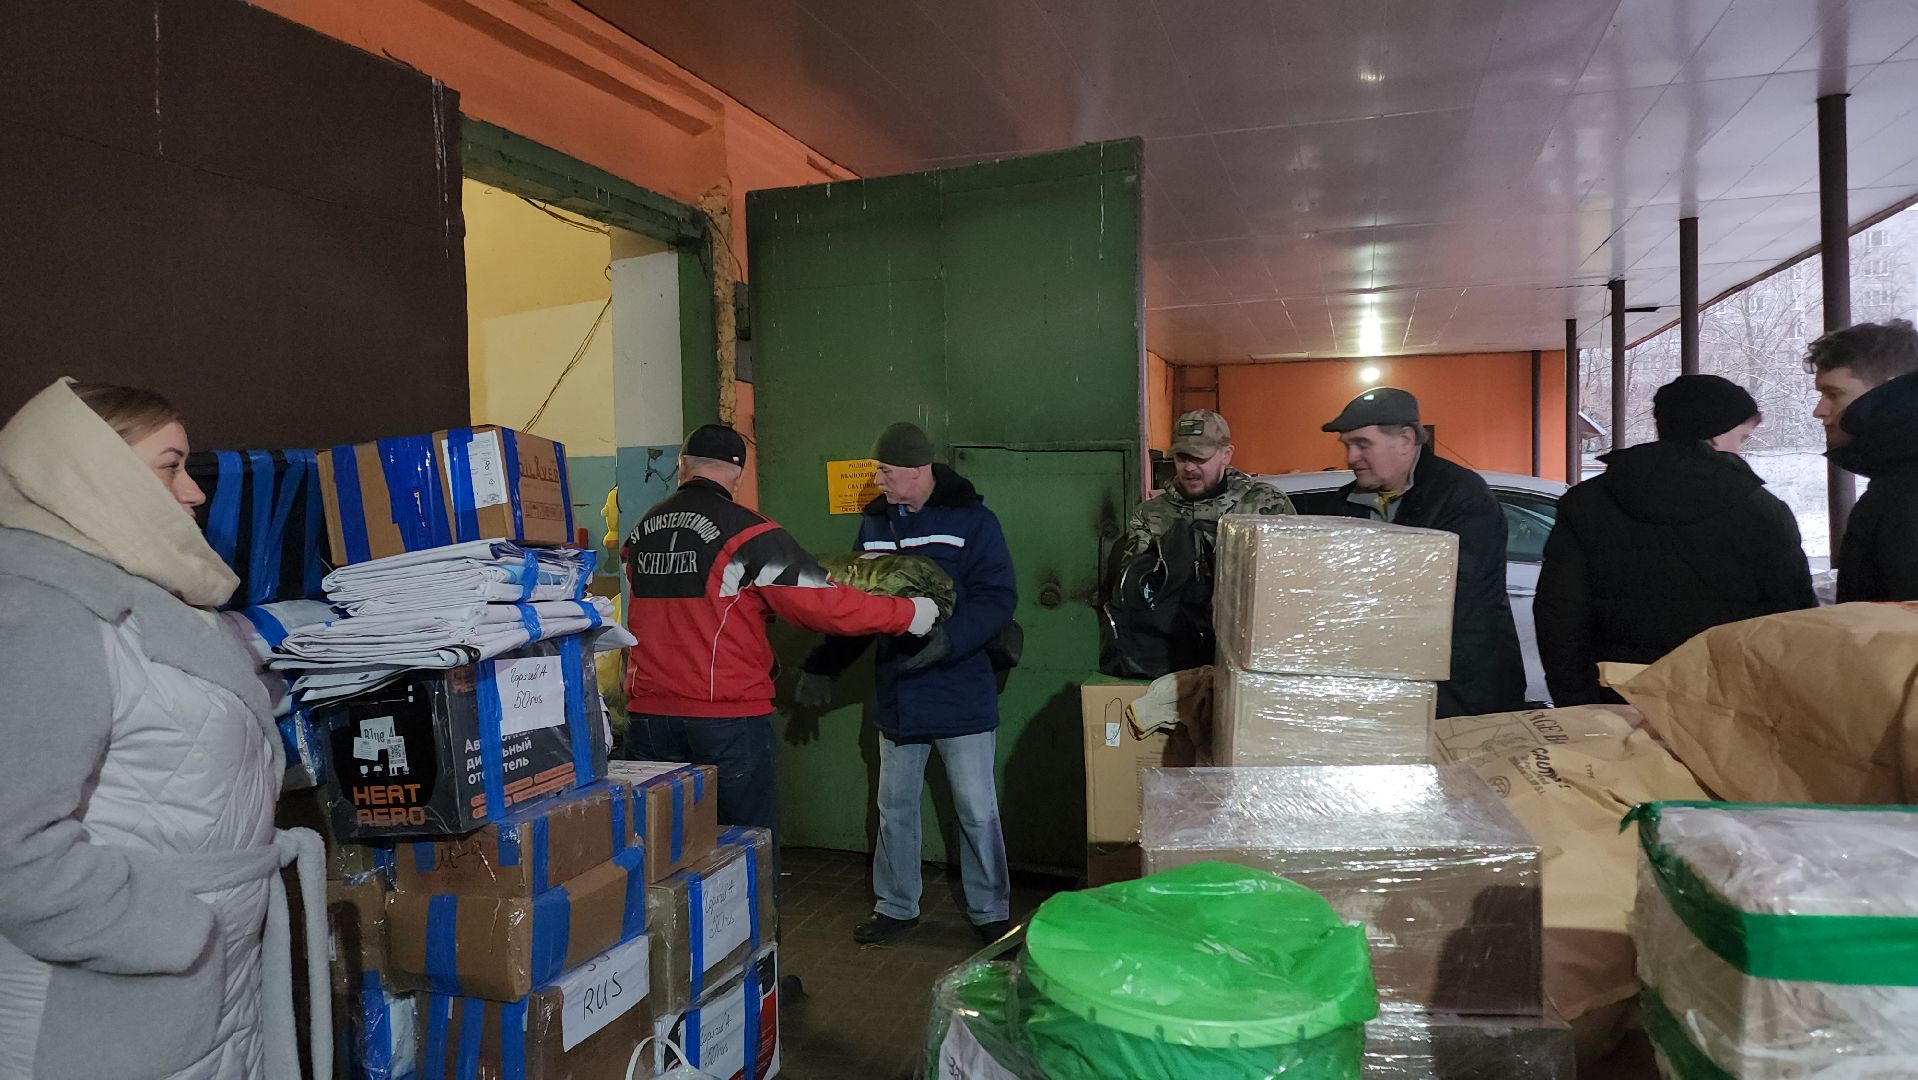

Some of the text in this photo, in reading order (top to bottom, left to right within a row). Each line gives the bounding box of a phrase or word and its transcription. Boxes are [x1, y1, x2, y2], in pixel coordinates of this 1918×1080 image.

[630, 526, 641, 545] SV
[352, 783, 421, 806] HEAT
[356, 806, 426, 827] AERO
[583, 971, 623, 1021] RUS
